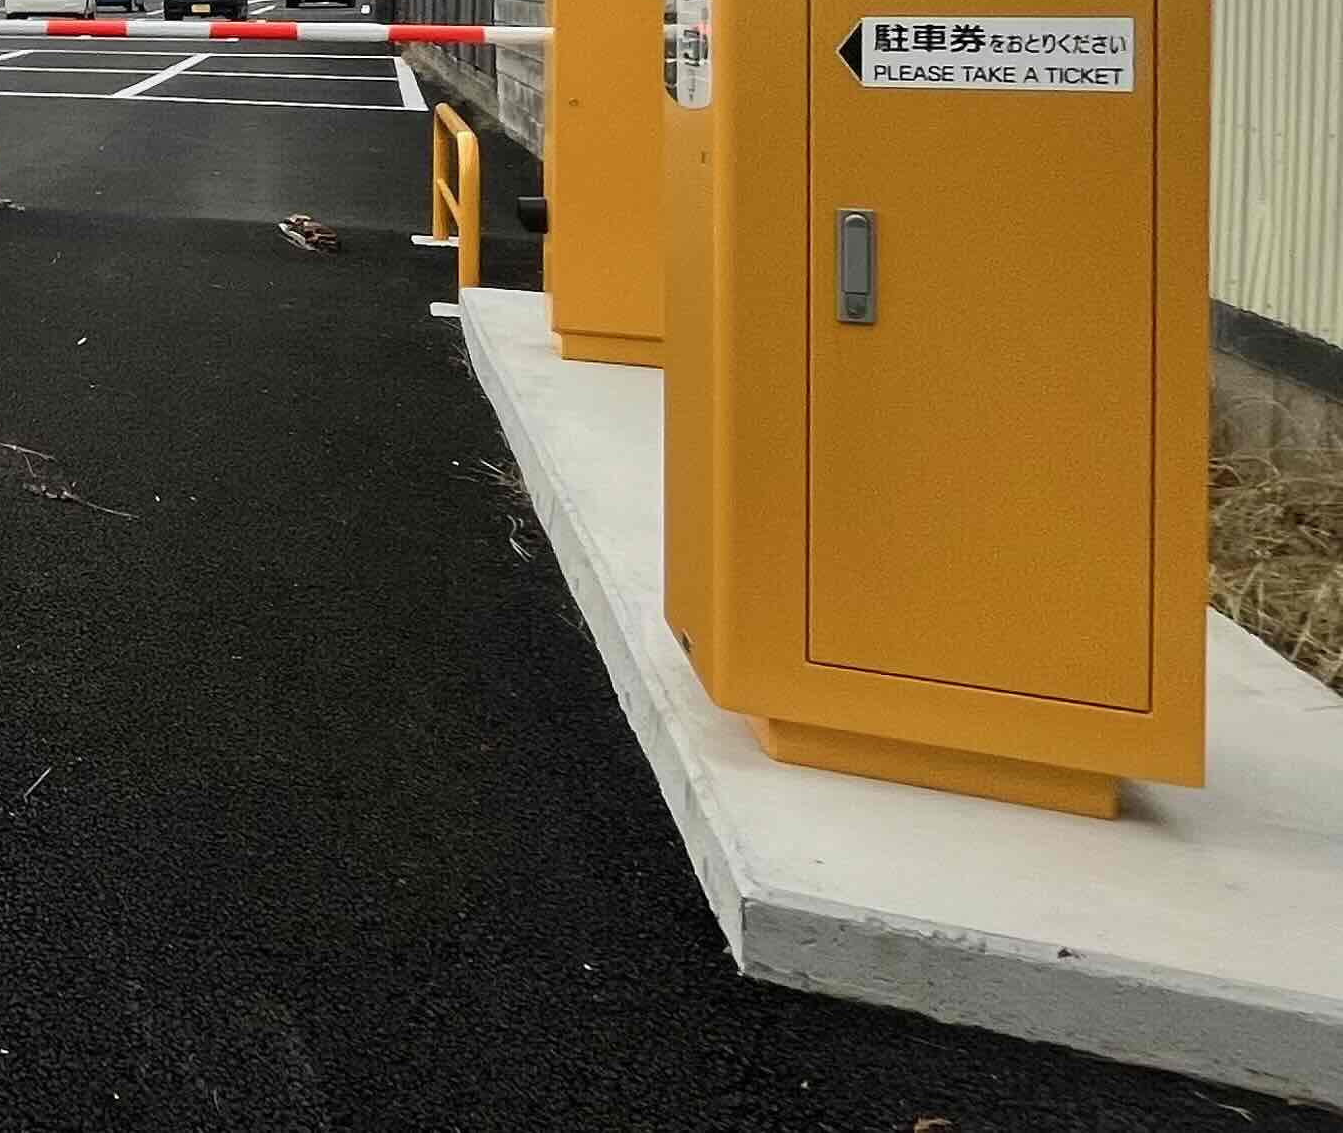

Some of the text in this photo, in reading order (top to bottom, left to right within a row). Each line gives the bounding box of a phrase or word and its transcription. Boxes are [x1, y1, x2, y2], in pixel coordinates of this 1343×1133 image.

[874, 24, 1127, 54] 駐車券をおとりください
[874, 65, 1124, 85] PLEASE TAKE A TICKET
